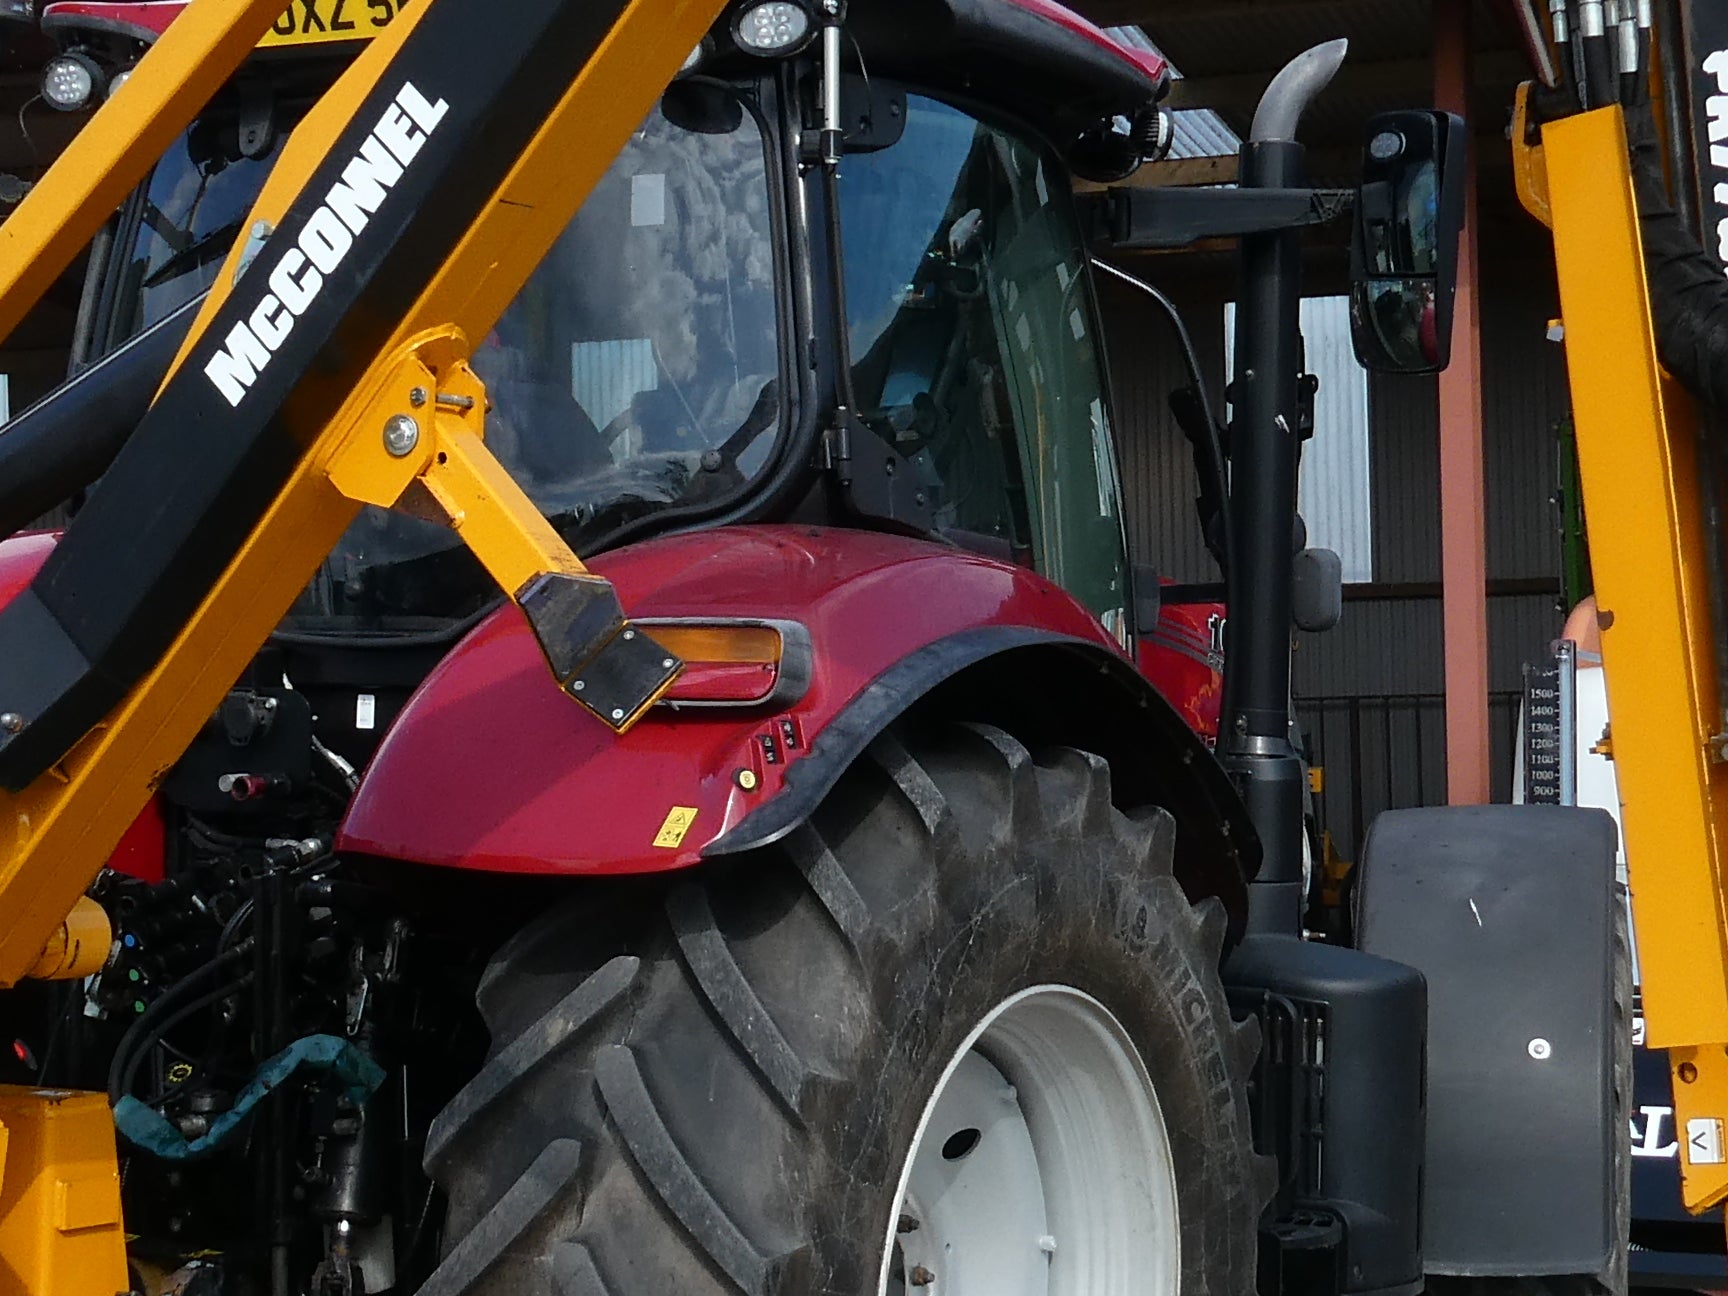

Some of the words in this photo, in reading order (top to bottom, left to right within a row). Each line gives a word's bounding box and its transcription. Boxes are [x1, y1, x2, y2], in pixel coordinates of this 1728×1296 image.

[204, 81, 450, 407] McCONNEL
[1530, 688, 1554, 699] 1500
[1530, 706, 1554, 717] 1400
[1530, 723, 1554, 733] 1300
[1530, 738, 1554, 750] 1200
[1531, 770, 1554, 780] 1000
[1533, 786, 1554, 796] 900
